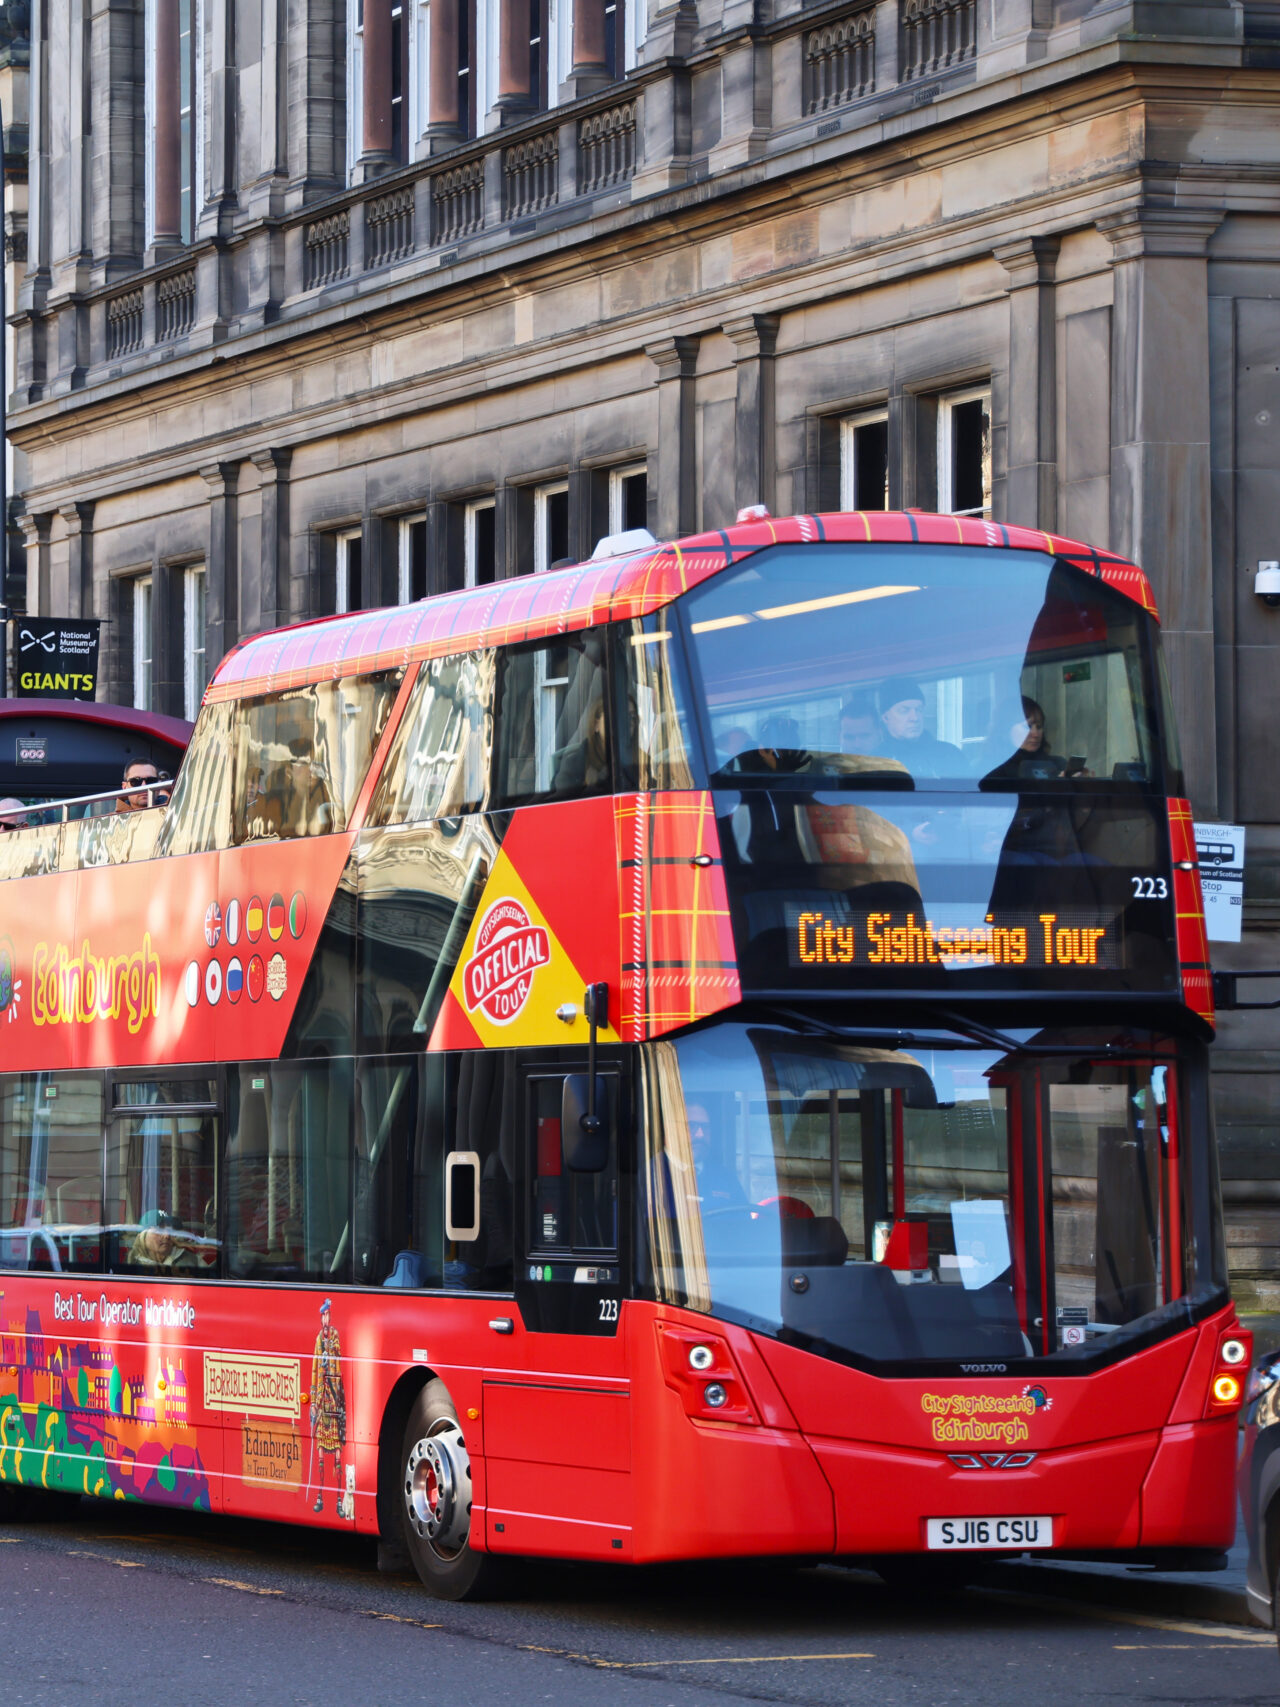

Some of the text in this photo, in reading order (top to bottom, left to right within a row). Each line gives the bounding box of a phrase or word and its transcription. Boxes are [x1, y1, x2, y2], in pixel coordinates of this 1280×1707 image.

[60, 631, 91, 640] National
[60, 639, 97, 648] Museum of
[59, 647, 90, 655] Scotland
[20, 672, 94, 691] GIANTS
[1219, 870, 1243, 878] Scotland
[1131, 876, 1168, 899] 223
[1201, 880, 1223, 892] Stop
[798, 912, 1105, 964] City Sightseeing Tour
[471, 932, 546, 999] OFFICIAL
[31, 931, 161, 1034] Edinburgh
[494, 978, 529, 1015] TOUR
[54, 1290, 196, 1329] Best Tour Operator Worldwide
[598, 1299, 618, 1321] 223
[959, 1363, 1008, 1373] VOLVO
[209, 1367, 295, 1403] HORRIBLE HISTORIES
[932, 1416, 1029, 1445] Edinburgh
[245, 1426, 299, 1469] Edinburgh
[253, 1459, 269, 1477] Terry
[269, 1461, 288, 1479] Deary
[941, 1519, 1039, 1544] SJ16 CSU
